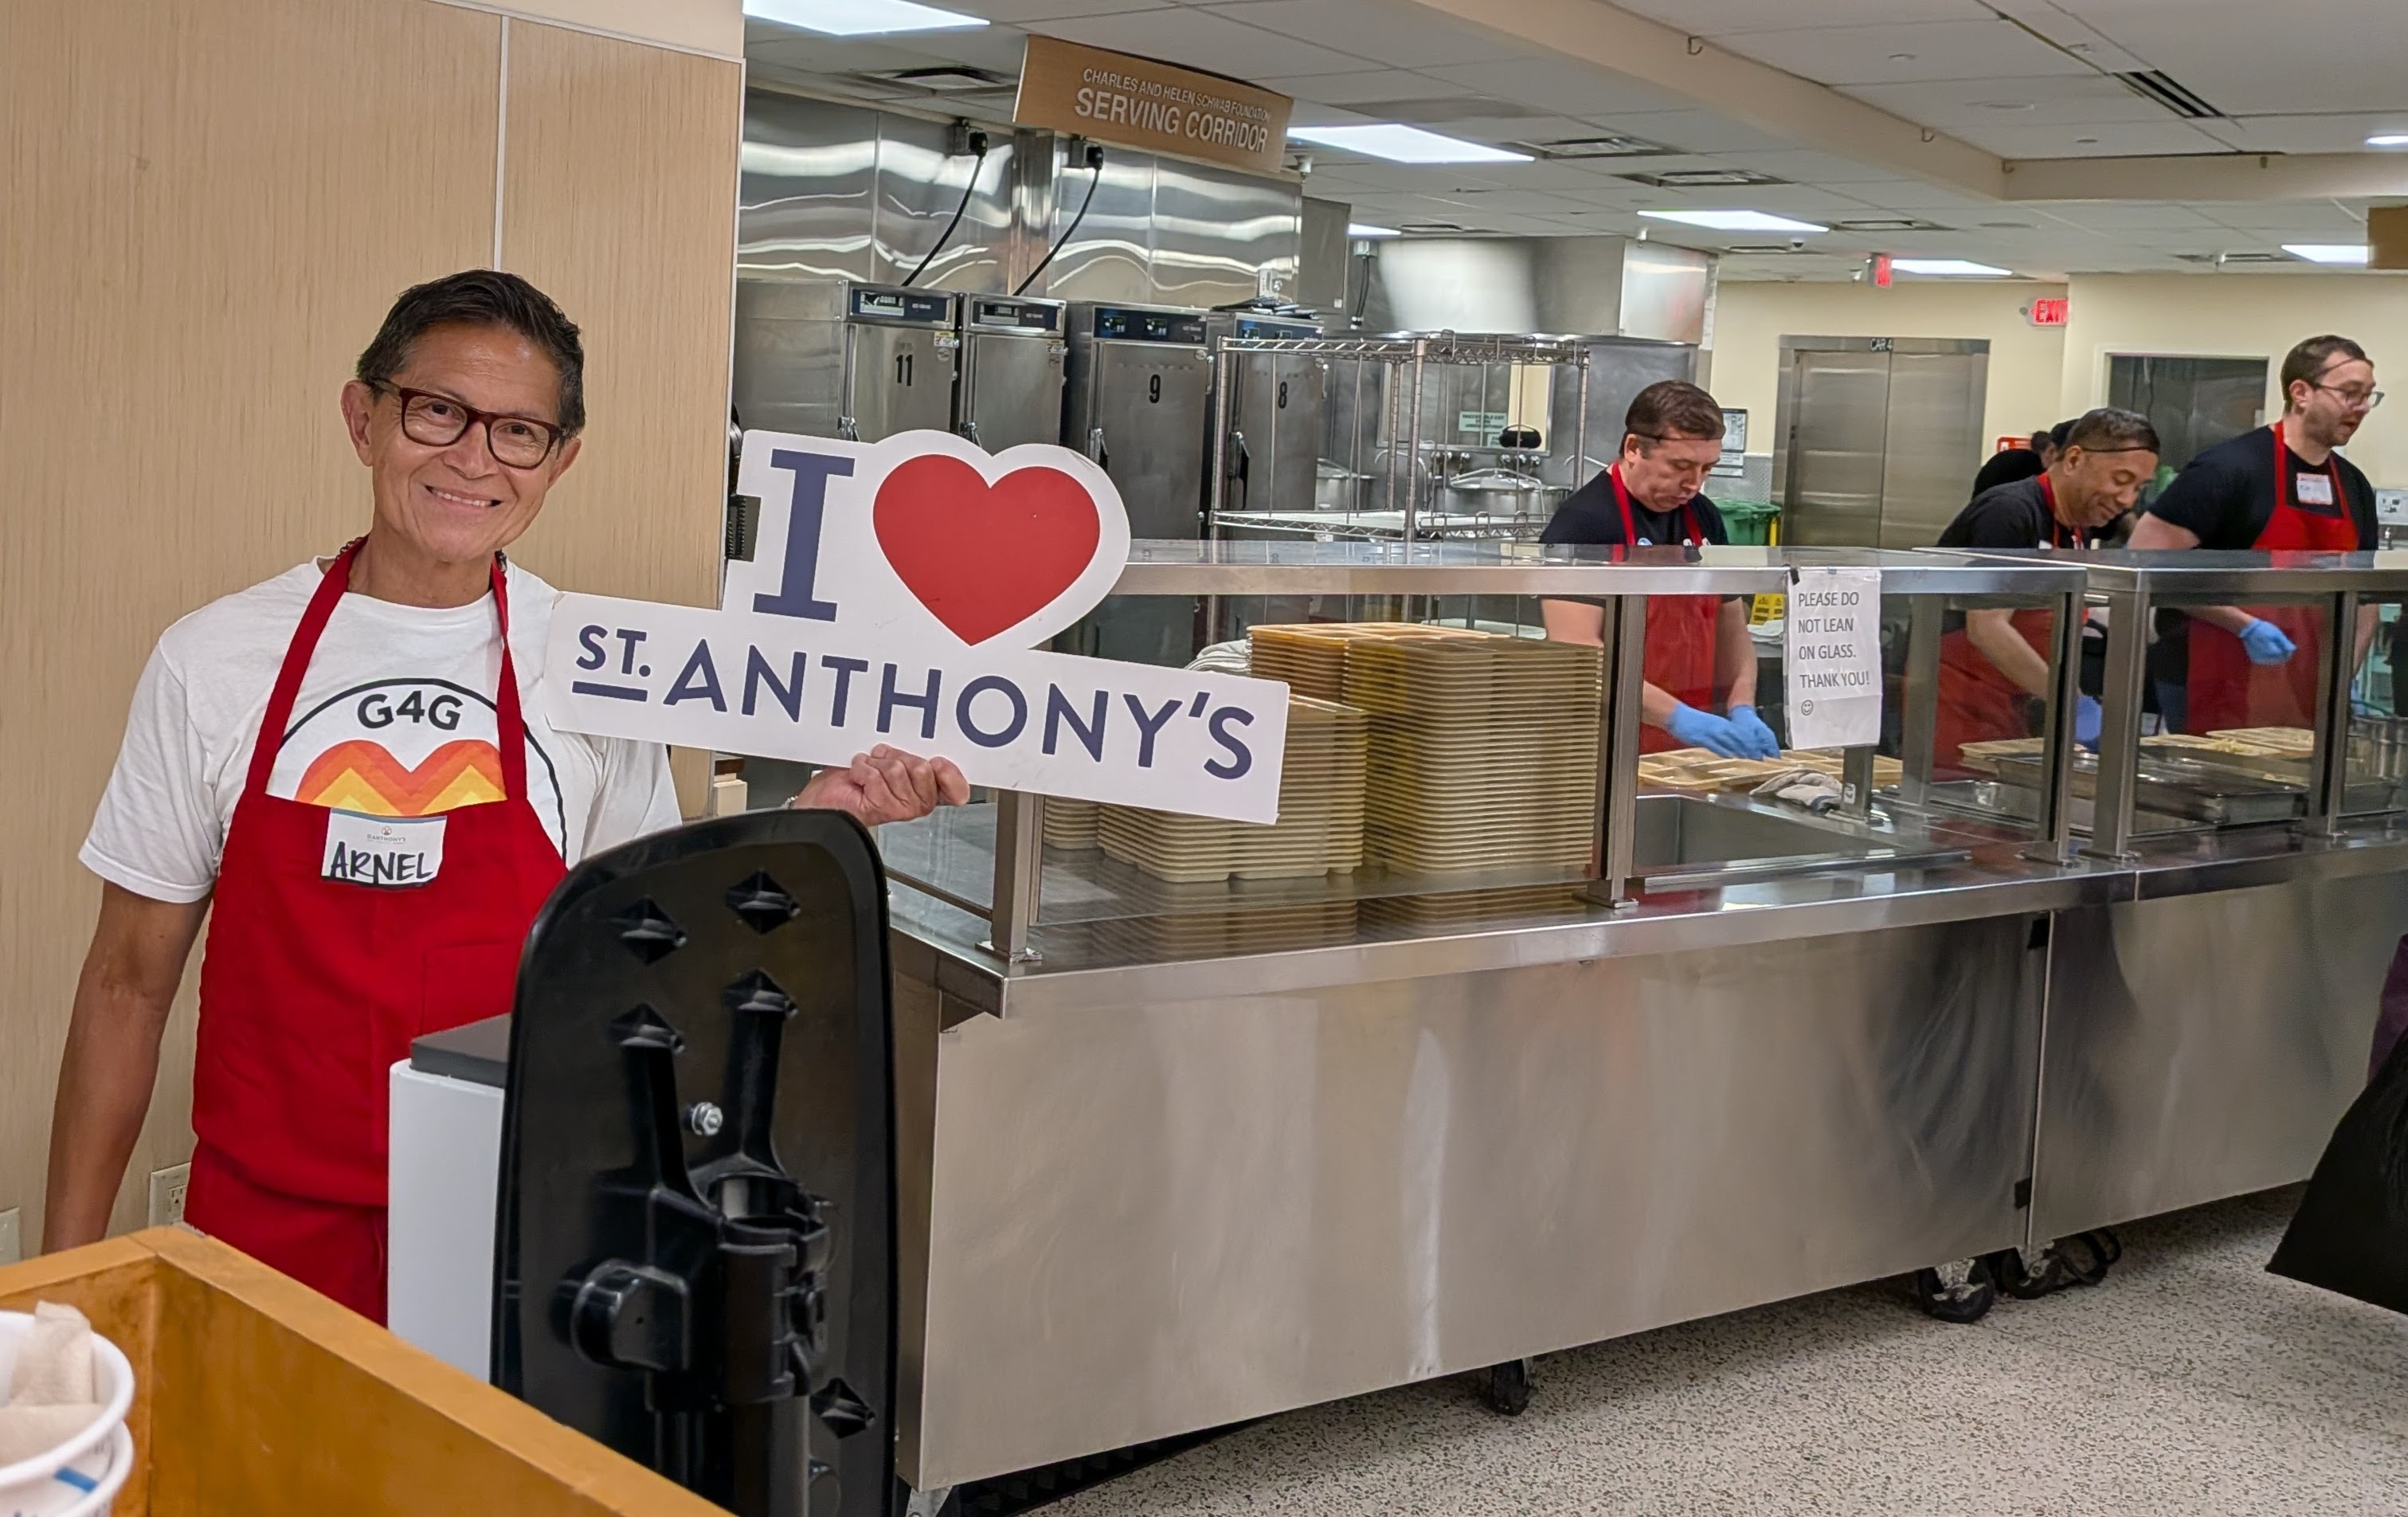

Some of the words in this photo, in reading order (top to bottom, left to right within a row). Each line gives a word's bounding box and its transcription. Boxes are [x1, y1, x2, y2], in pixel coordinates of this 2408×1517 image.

[1083, 68, 1138, 92] CHARLES
[1138, 80, 1162, 96] AND
[1163, 86, 1196, 105] HELEN
[1196, 93, 1231, 113] SCHWAB
[1075, 88, 1181, 135] SERVING
[1185, 111, 1268, 153] CORRIDOR
[1870, 337, 1886, 351] CAR
[896, 354, 913, 386] 11
[1149, 374, 1161, 404] 9
[1278, 381, 1287, 409] 8
[752, 449, 856, 622] I
[1799, 592, 1838, 607] PLEASE
[1842, 591, 1859, 606] DO
[1798, 618, 1821, 633] NOT
[1824, 618, 1854, 633] LEAN
[1799, 645, 1815, 660] ON
[1819, 644, 1857, 659] GLASS.
[1799, 673, 1839, 688] THANK
[1842, 671, 1870, 687] YOU!
[357, 690, 464, 731] G4G
[574, 625, 651, 677] ST.
[663, 637, 1255, 779] ANTHONY'S
[329, 841, 433, 884] ARNEL
